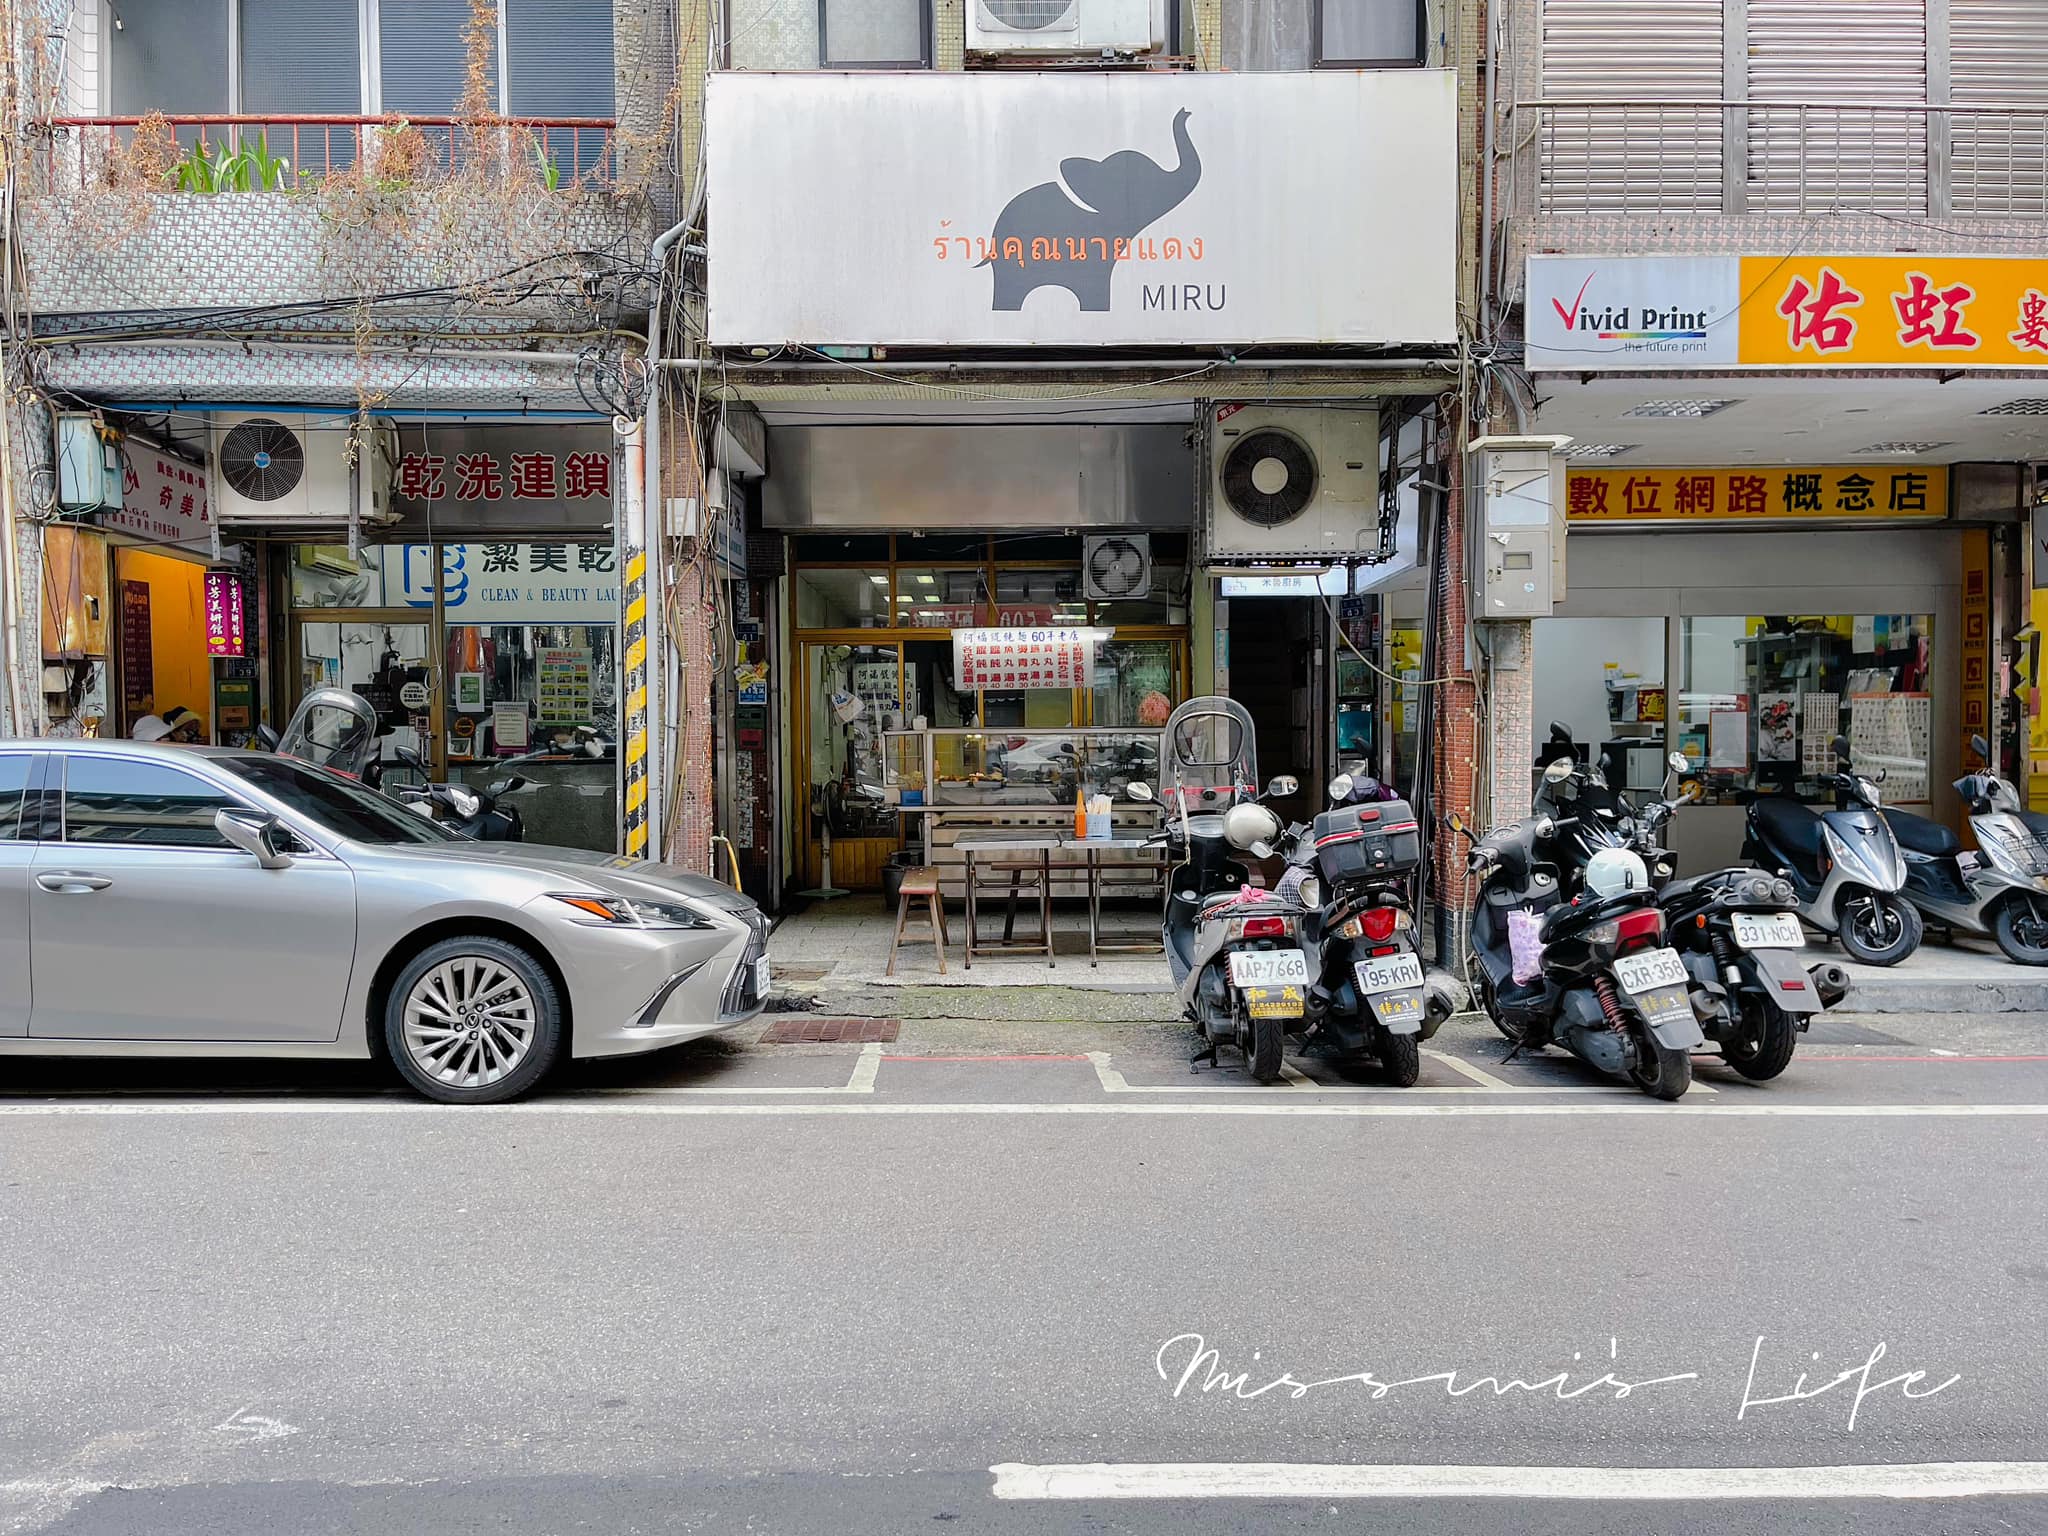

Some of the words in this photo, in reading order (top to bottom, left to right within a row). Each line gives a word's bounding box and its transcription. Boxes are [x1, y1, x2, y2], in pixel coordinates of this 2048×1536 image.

[1142, 284, 1226, 311] MIRU
[1552, 271, 1629, 330] Vivid
[1642, 306, 1707, 331] Print
[1625, 342, 1642, 352] the
[1646, 341, 1678, 352] future
[1682, 342, 1707, 354] print
[400, 453, 611, 500] 乾洗連鎖
[1569, 473, 1928, 515] 數位網路概念店
[481, 588, 519, 601] CLEAN
[526, 588, 533, 601] &
[542, 588, 588, 601] BEAUTY
